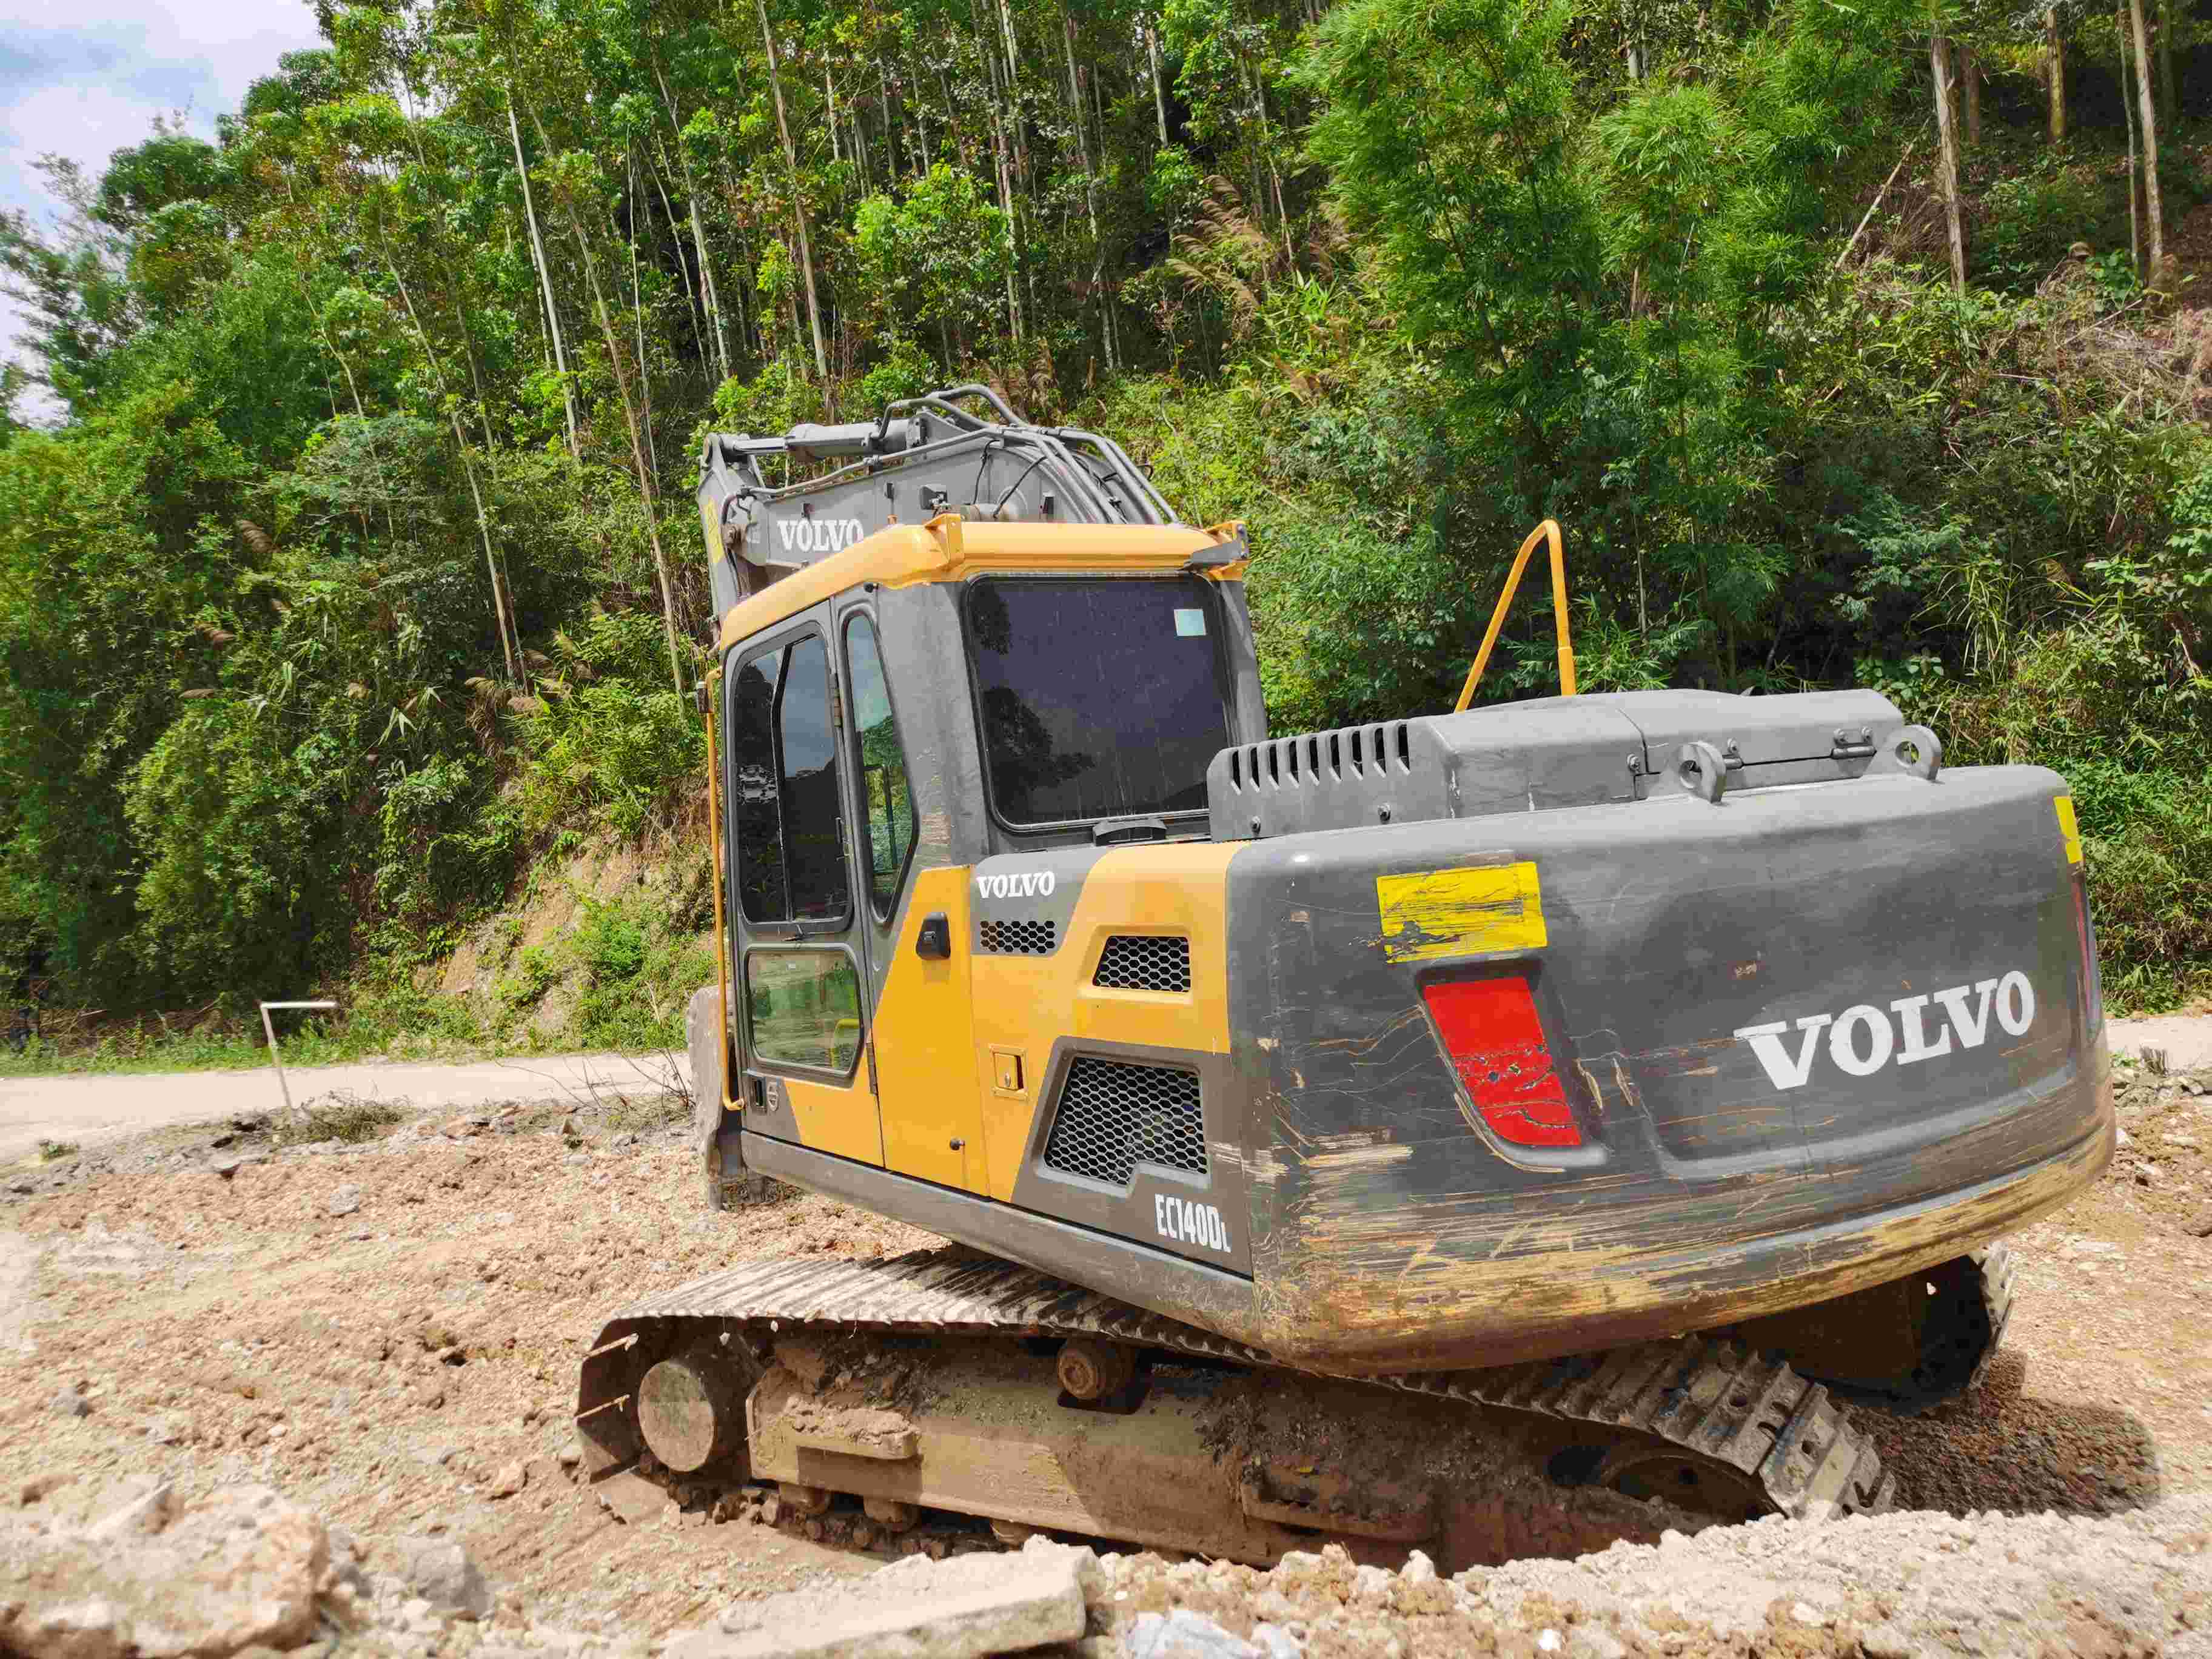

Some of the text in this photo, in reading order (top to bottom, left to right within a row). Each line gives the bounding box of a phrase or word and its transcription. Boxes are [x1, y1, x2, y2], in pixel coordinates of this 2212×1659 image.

[777, 518, 864, 552] VOLVO
[976, 871, 1055, 899] VOLVO
[1734, 970, 2035, 1090] VOLVO
